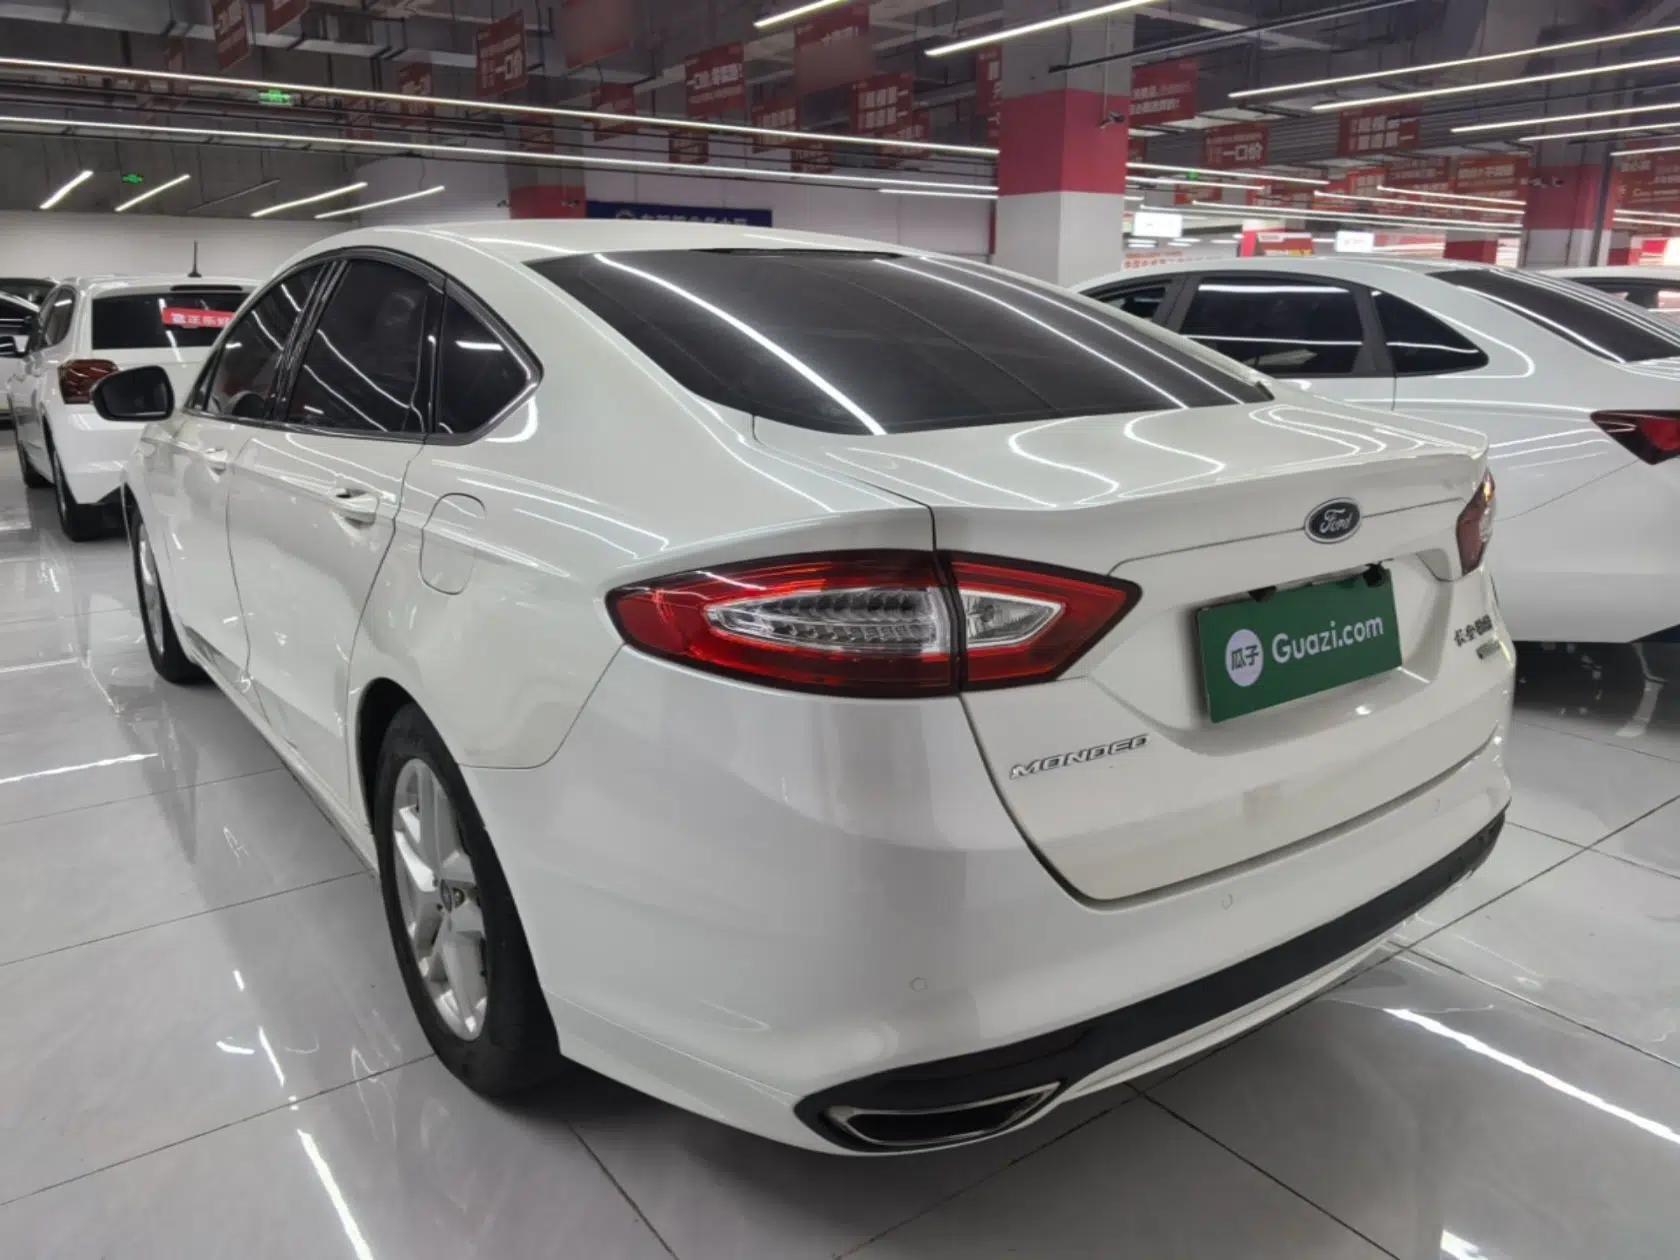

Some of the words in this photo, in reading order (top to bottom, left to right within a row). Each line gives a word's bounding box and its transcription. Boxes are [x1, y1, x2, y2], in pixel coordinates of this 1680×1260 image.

[1319, 507, 1353, 534] Ford
[1230, 644, 1260, 672] 瓜子
[1271, 616, 1385, 664] Guazi.com
[1009, 733, 1148, 780] MONDEO
